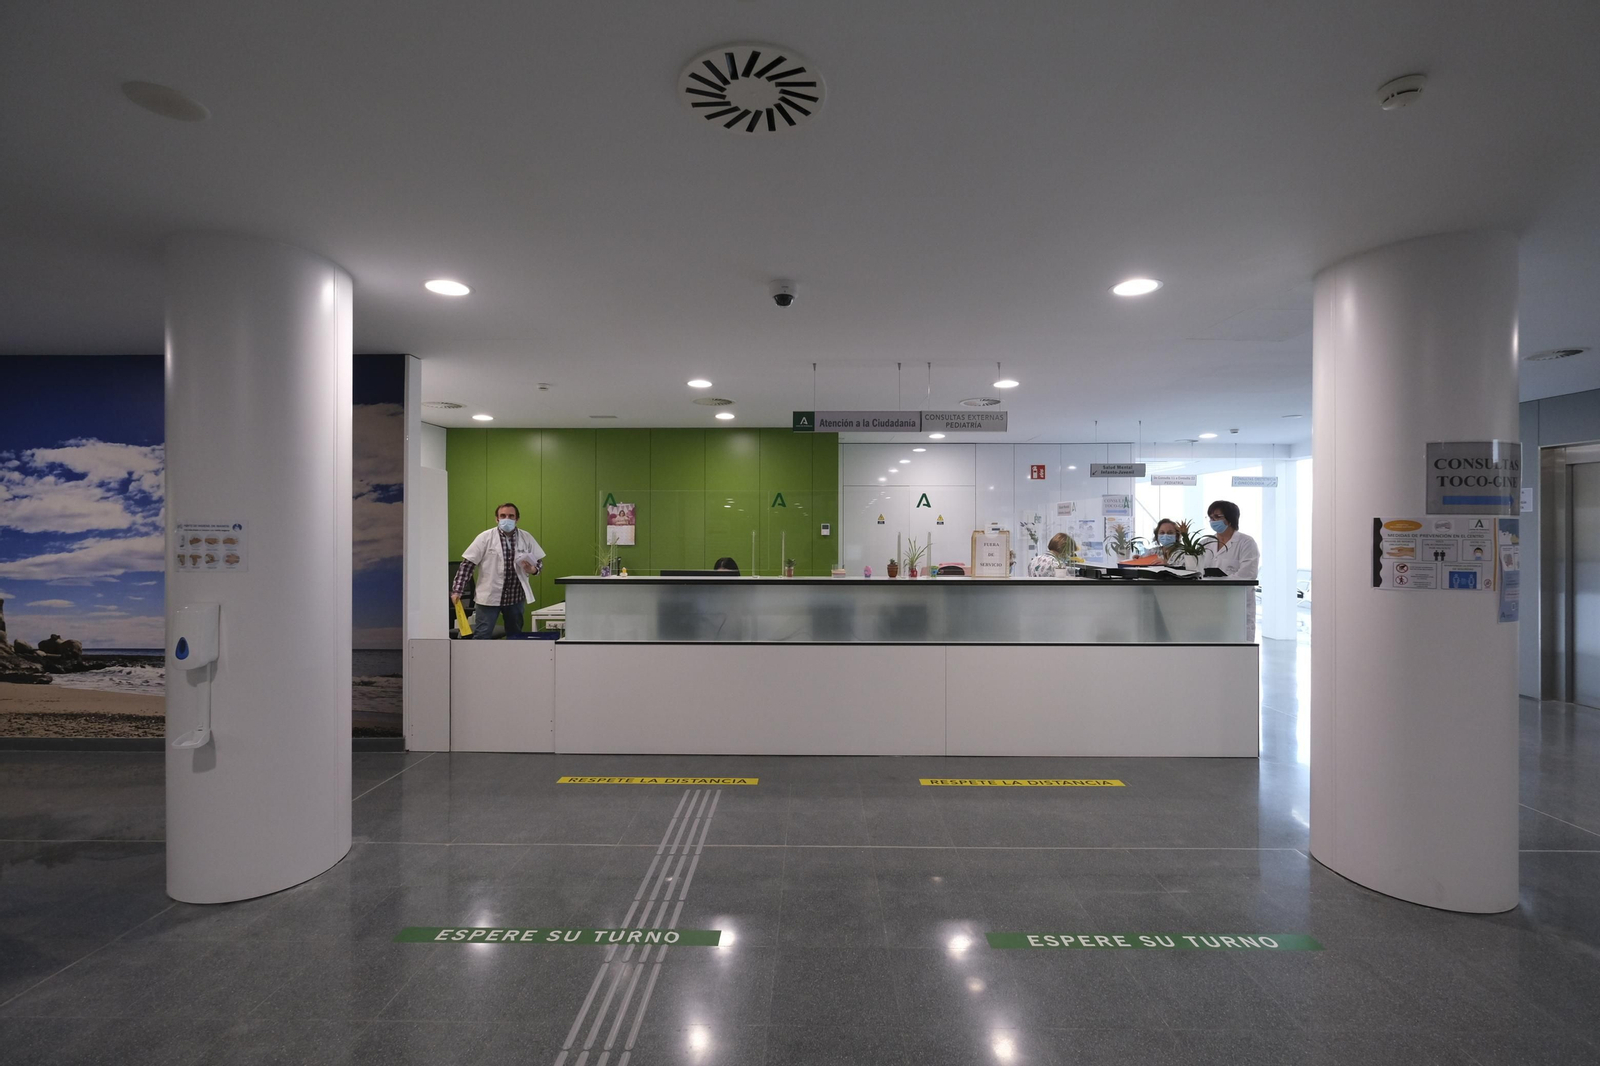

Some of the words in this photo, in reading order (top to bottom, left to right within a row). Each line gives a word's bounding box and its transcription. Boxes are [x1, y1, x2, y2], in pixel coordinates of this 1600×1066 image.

[819, 418, 854, 428] Atención
[855, 420, 861, 428] a
[863, 418, 869, 428] la
[872, 418, 916, 428] Ciudadanía
[945, 421, 982, 429] PEDIATRÍA
[1433, 458, 1520, 471] CONSULTAS
[434, 929, 539, 941] ESPERE
[546, 930, 582, 942] SU
[594, 931, 680, 943] TURNO
[1026, 935, 1132, 947] ESPERE
[1139, 935, 1176, 947] SU
[1182, 936, 1279, 948] TURNO
